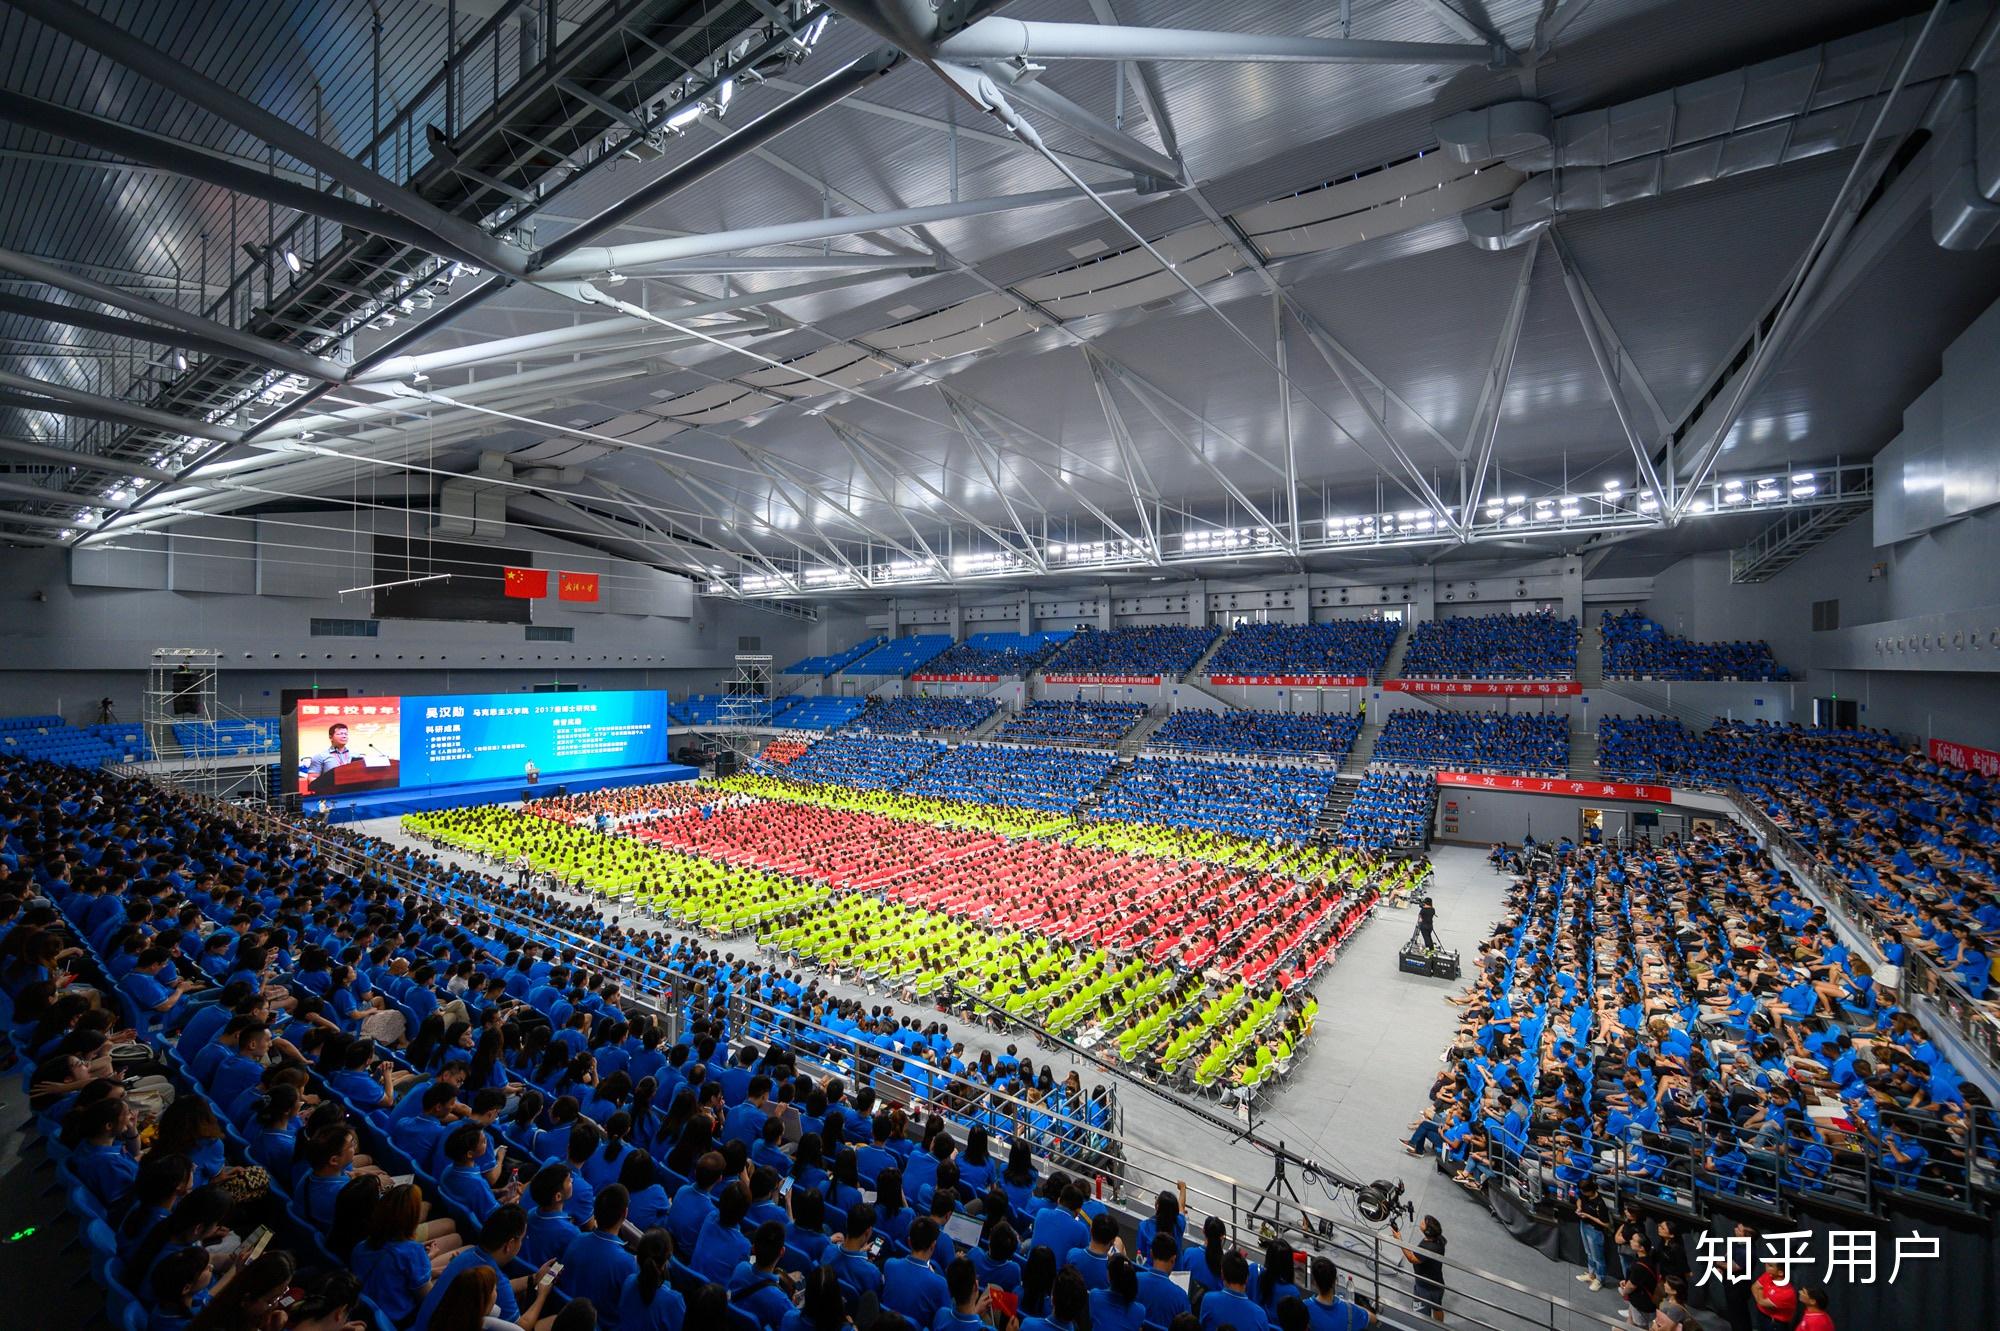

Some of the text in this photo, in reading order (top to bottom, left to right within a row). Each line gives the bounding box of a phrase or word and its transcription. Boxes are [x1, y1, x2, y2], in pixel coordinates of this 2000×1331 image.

[1400, 682, 1569, 693] 为祖国点赞 为青春喝彩
[302, 705, 400, 715] 国高校青年
[1455, 775, 1648, 798] 研究生开学典礼
